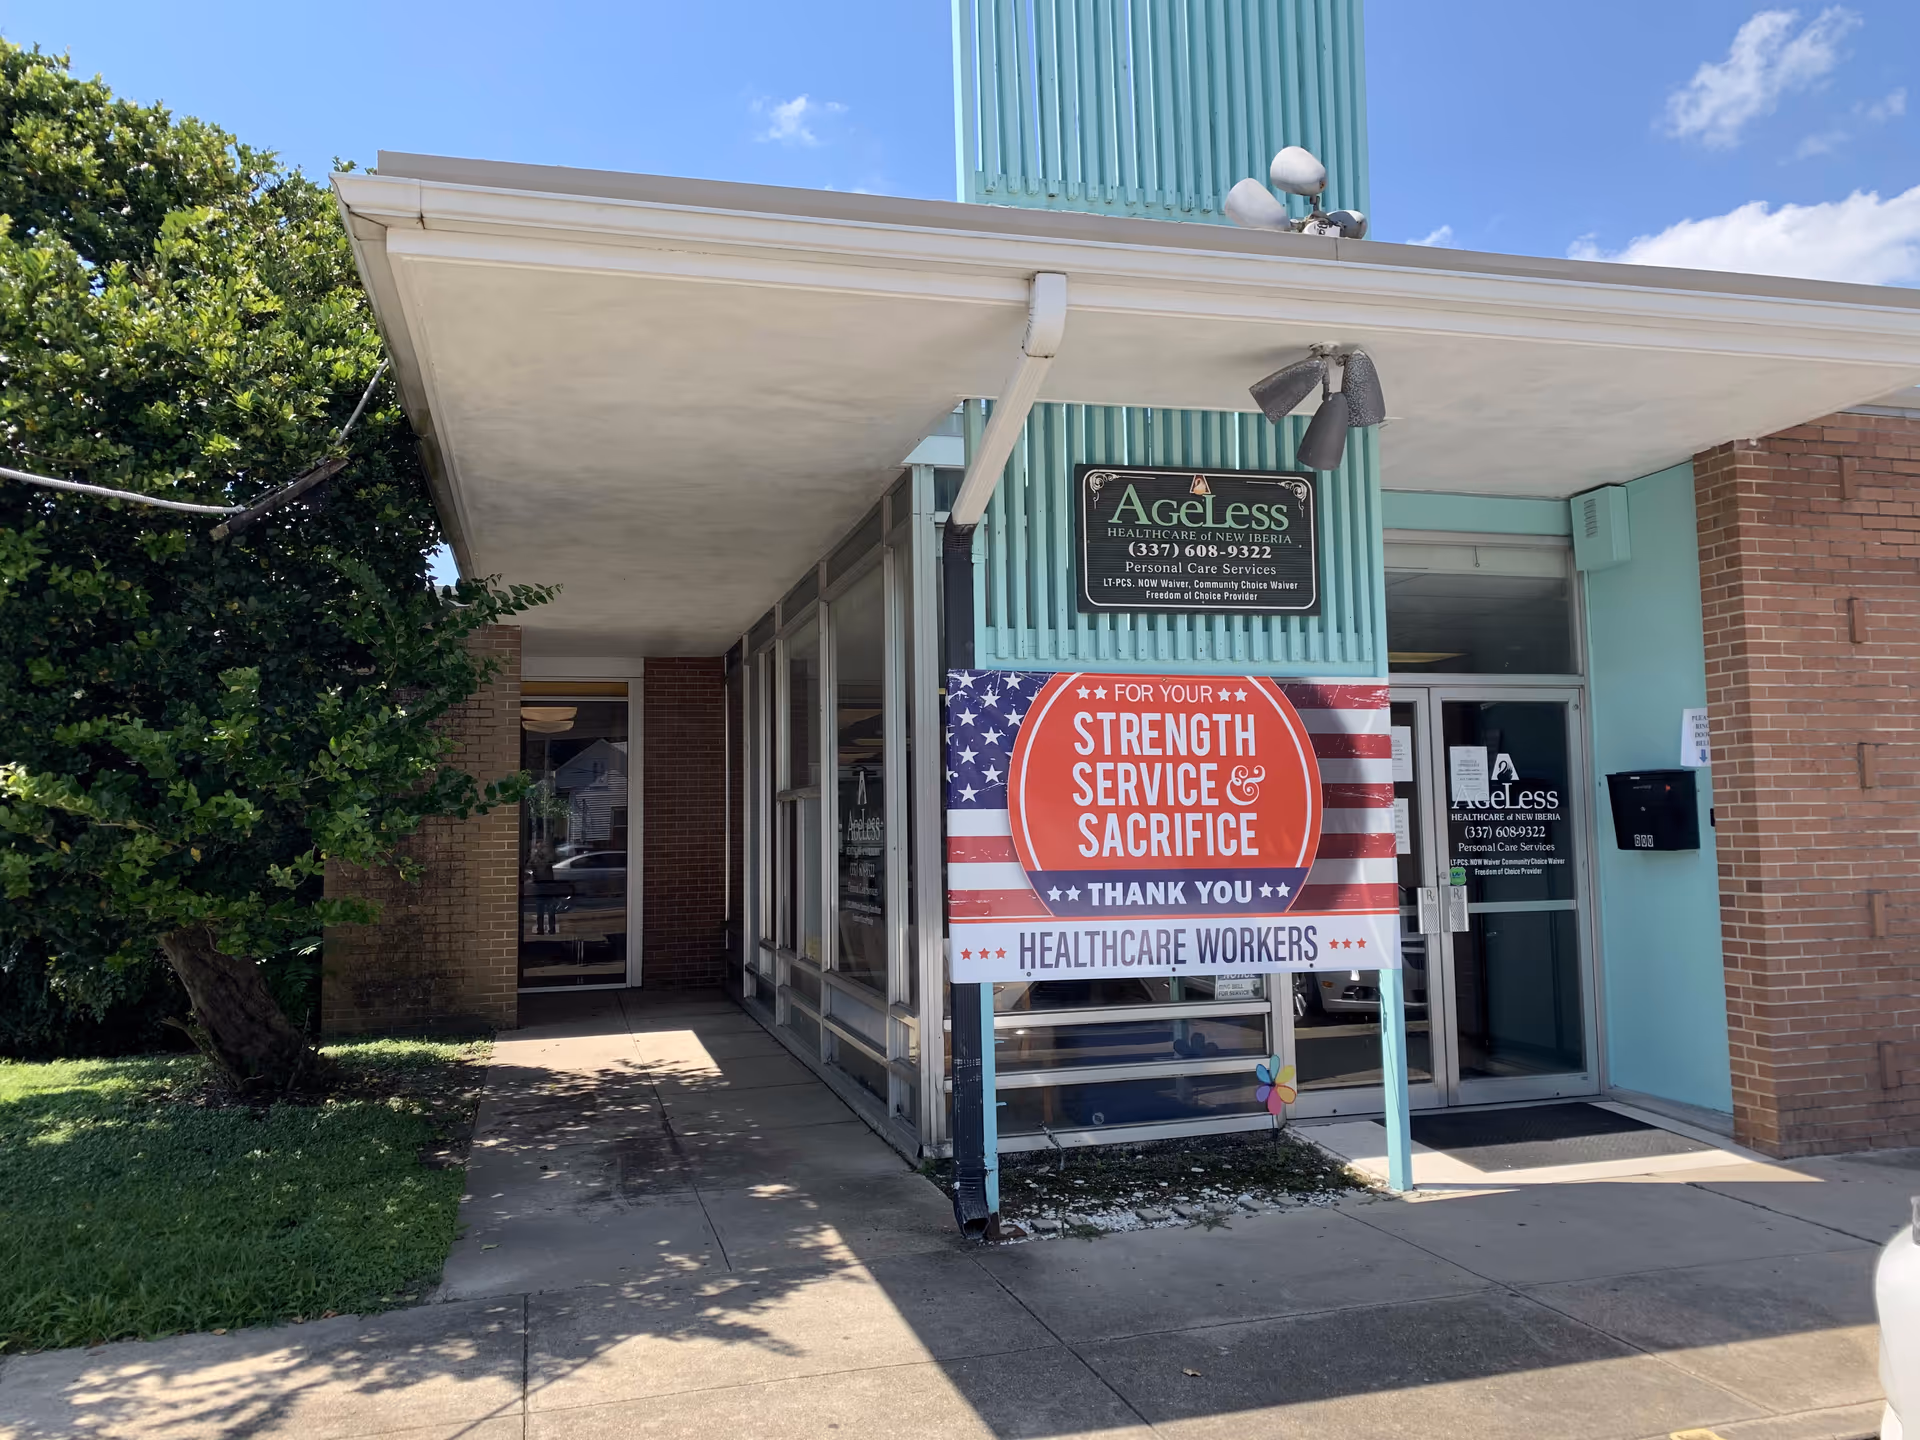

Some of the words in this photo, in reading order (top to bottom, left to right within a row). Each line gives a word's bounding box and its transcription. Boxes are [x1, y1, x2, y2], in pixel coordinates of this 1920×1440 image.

[1107, 527, 1197, 541] HEALTHCARE
[1200, 531, 1212, 541] of
[1216, 532, 1245, 542] NEW
[1249, 533, 1292, 544] IBERIA
[1128, 541, 1180, 559] (337)
[1184, 543, 1272, 559] 608-9322
[1125, 561, 1182, 574] Personal
[1187, 562, 1218, 574] Care
[1222, 563, 1277, 575] Services
[1138, 578, 1158, 588] NOW
[1194, 579, 1238, 590] Community
[1241, 580, 1268, 590] Choice
[1270, 581, 1298, 590] Waiver
[1146, 590, 1181, 600] Freedom
[1183, 591, 1192, 600] of
[1194, 591, 1222, 601] Choice
[1224, 591, 1258, 601] Provider
[1114, 683, 1154, 702] FOR
[1159, 684, 1213, 703] YOUR
[1073, 711, 1256, 756] STRENGTH
[1072, 762, 1219, 807] SERVICE
[1226, 765, 1266, 806] &
[1451, 813, 1505, 821] HEALTHCARE
[1506, 813, 1514, 821] of
[1515, 813, 1534, 821] NEW
[1535, 813, 1561, 821] IBERIA
[1078, 812, 1259, 858] SACRIFICE
[1464, 825, 1492, 839] (337)
[1495, 825, 1546, 839] 608-9322
[1458, 842, 1496, 852] Personal
[1497, 842, 1518, 852] Care
[1520, 842, 1555, 852] Services
[1501, 858, 1530, 866] Community
[1548, 857, 1565, 865] Waiver
[1474, 868, 1497, 876] Freedom
[1521, 867, 1542, 875] Provider
[1087, 881, 1187, 906] THANK
[1194, 880, 1252, 904] YOU
[1019, 928, 1187, 970] HEALTHCARE
[1196, 924, 1318, 965] WORKERS
